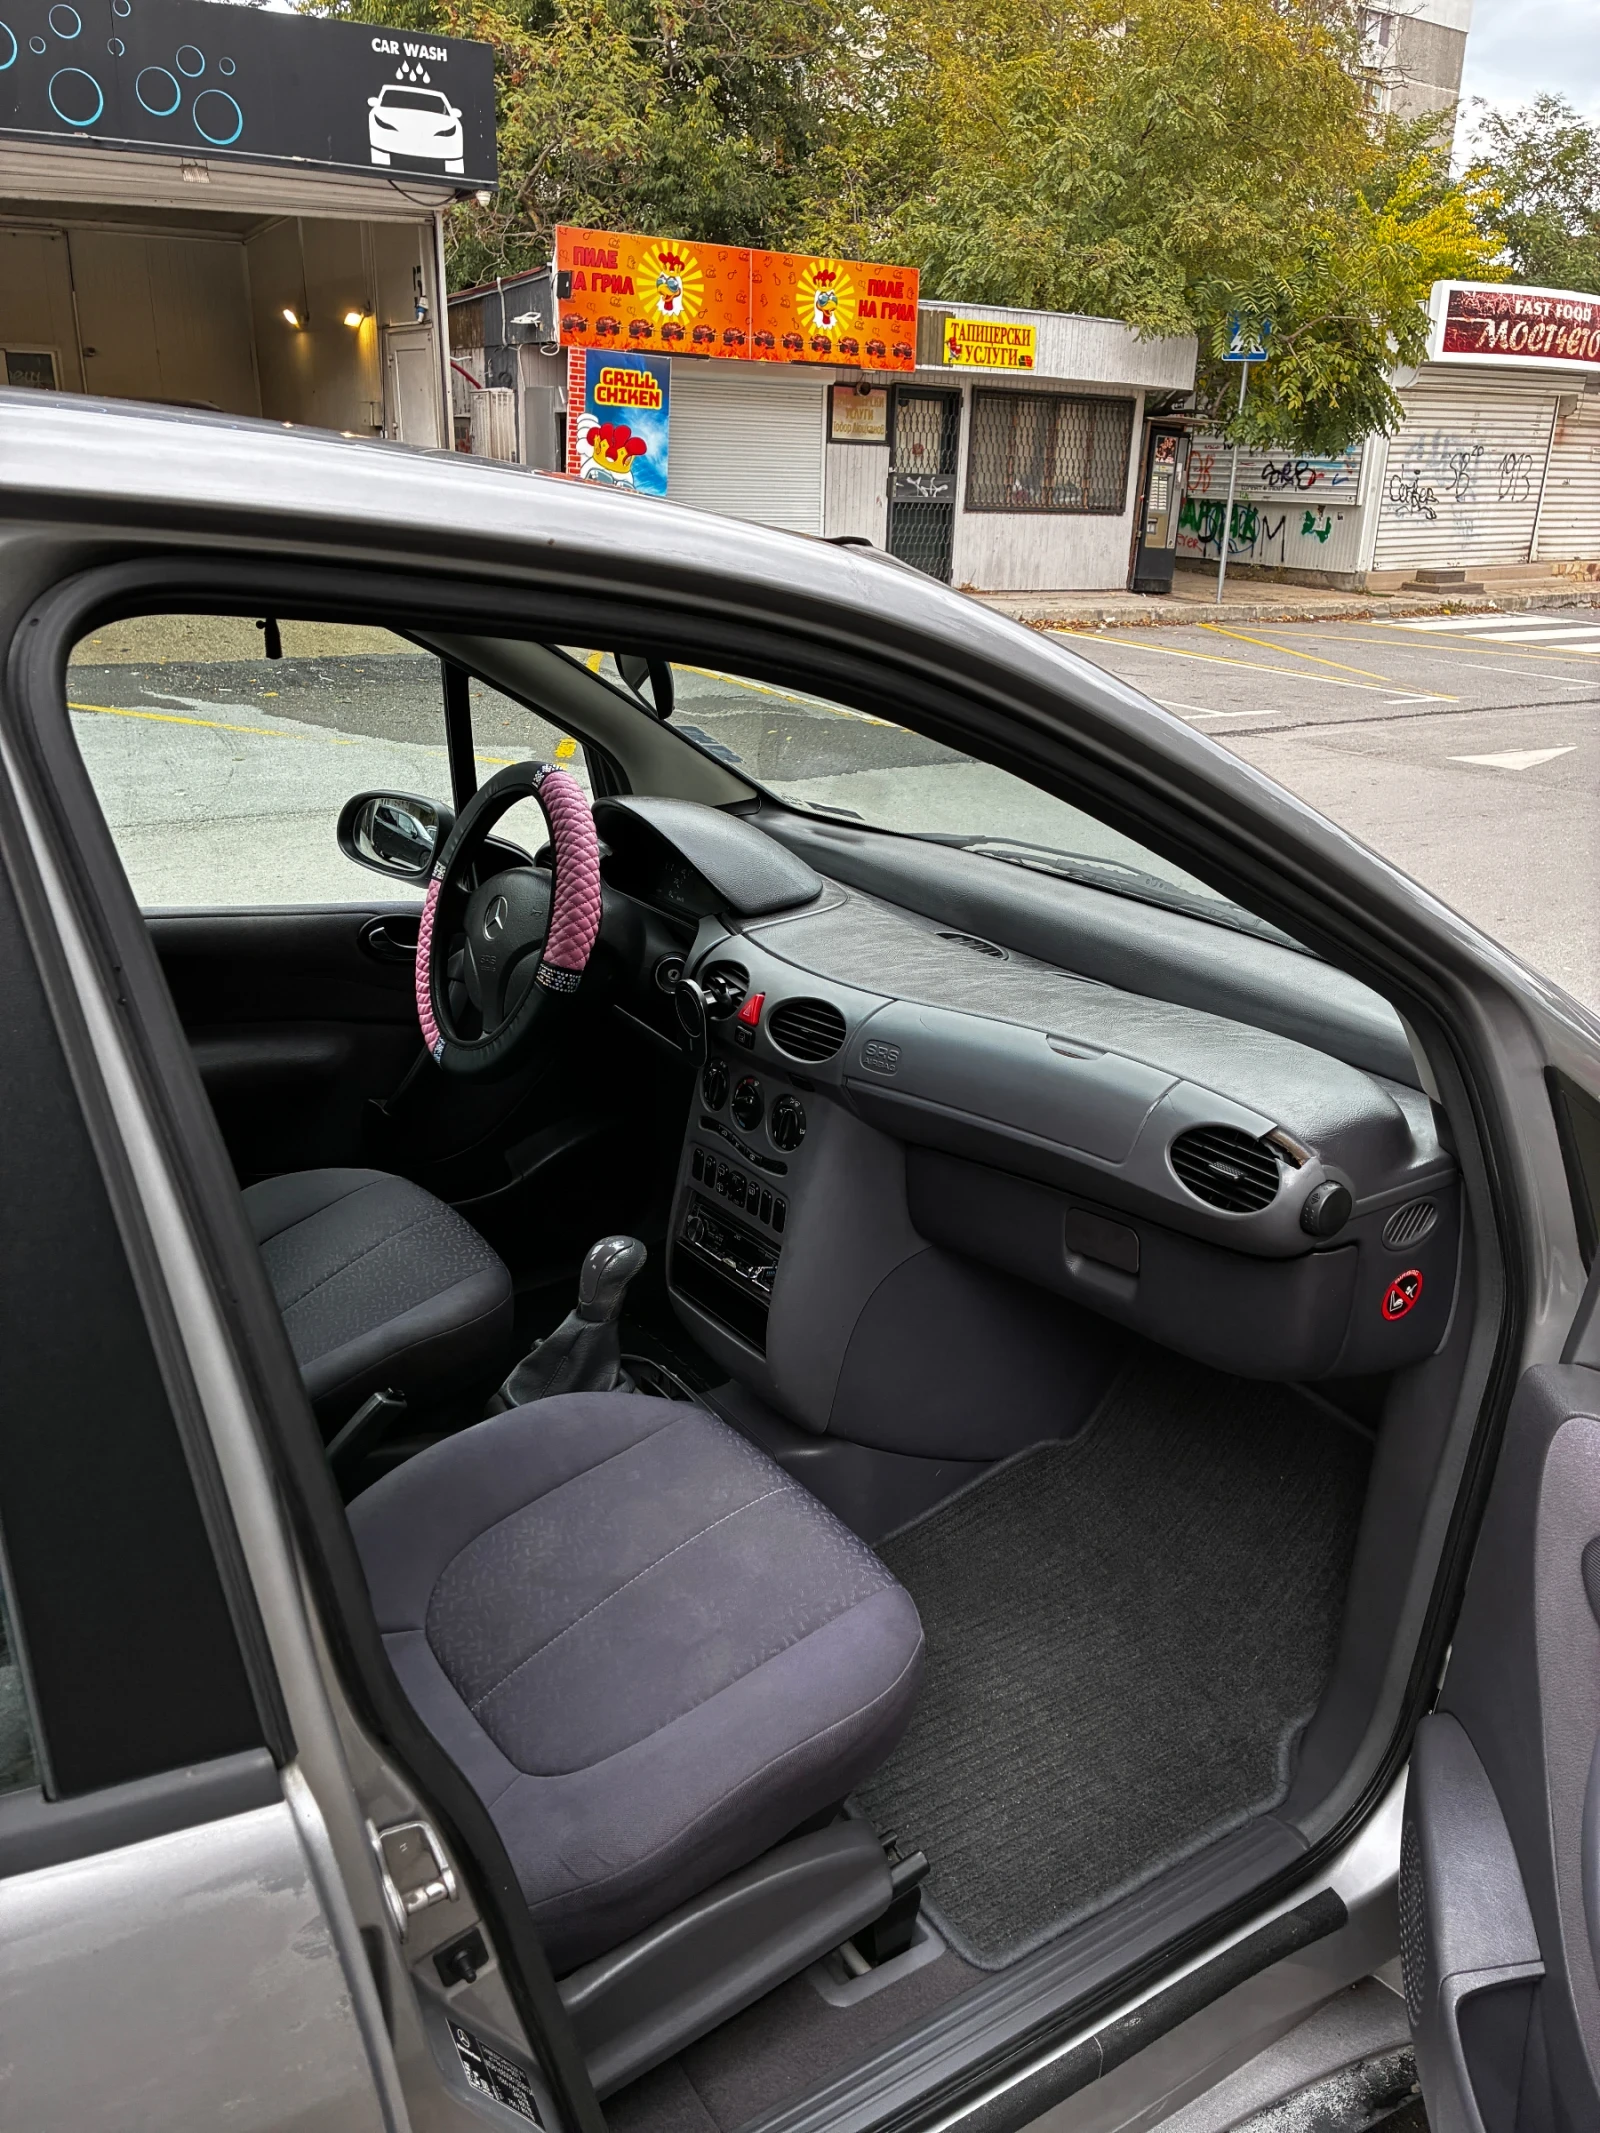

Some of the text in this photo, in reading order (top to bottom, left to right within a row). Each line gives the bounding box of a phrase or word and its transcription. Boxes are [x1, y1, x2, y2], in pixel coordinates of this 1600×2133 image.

[371, 37, 448, 62] CAR WASH
[572, 245, 619, 270] ПИЛЕ
[591, 272, 635, 296] ГРИЛ
[867, 278, 905, 300] ПИЛЕ
[858, 299, 916, 322] НА ГРИЛ
[1514, 300, 1592, 323] FAST FOOD
[950, 322, 1032, 347] ТАПИЦЕРСКИ
[964, 344, 1019, 366] УСЛУГИ
[601, 369, 657, 390] GRILL
[596, 386, 661, 408] CHIKEN
[865, 1043, 900, 1062] SRS
[863, 1057, 896, 1071] AIRBAG
